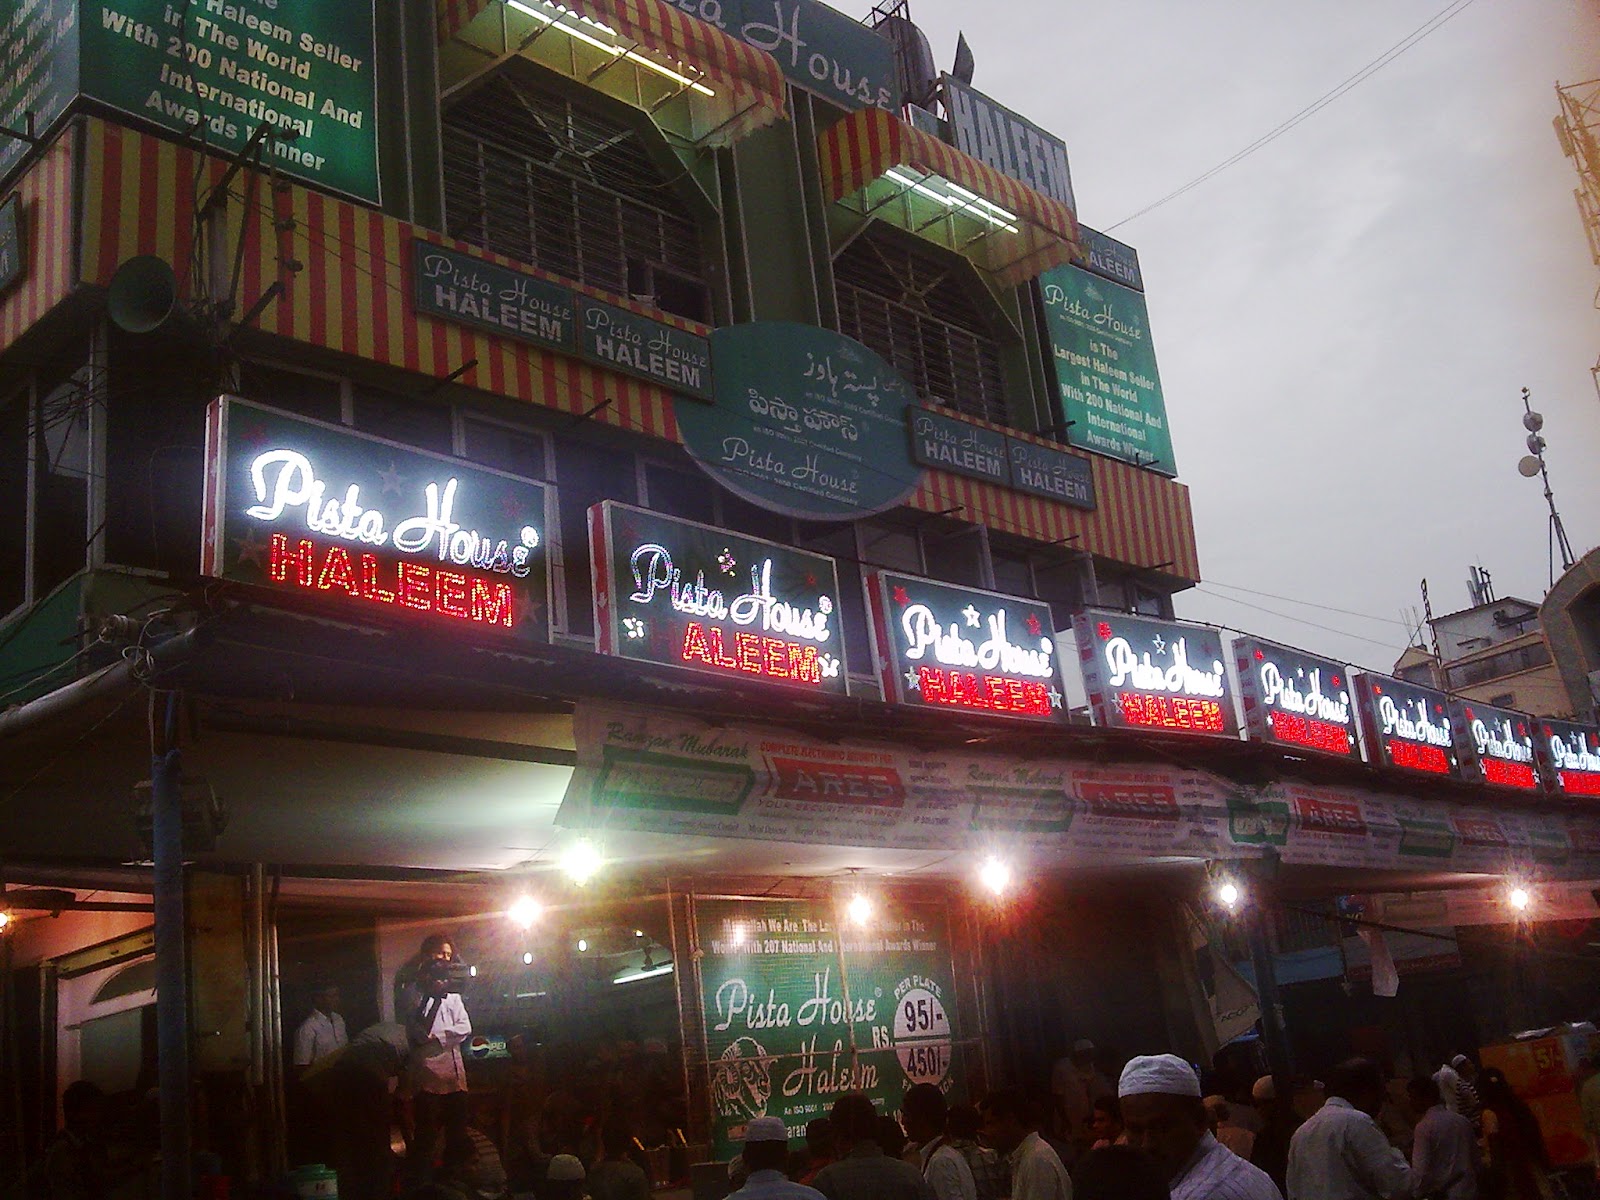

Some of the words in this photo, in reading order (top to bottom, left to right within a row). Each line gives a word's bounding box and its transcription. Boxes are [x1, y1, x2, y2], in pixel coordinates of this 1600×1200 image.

[196, 17, 239, 50] The
[247, 38, 311, 80] World
[206, 0, 292, 43] Haleem
[299, 33, 361, 72] Seller
[741, 1, 893, 112] House
[102, 7, 159, 48] With
[166, 36, 211, 69] 200
[219, 57, 314, 110] National
[321, 99, 362, 129] And
[160, 64, 313, 138] International
[424, 255, 492, 296] Pista
[500, 279, 571, 321] House
[1088, 251, 1135, 282] ALEEM
[435, 284, 561, 342] HALEEM
[586, 307, 642, 346] Pista
[648, 330, 707, 368] House
[1045, 284, 1090, 320] Pista
[1094, 304, 1141, 340] House
[596, 334, 700, 388] HALEEM
[1054, 344, 1091, 369] Largest
[1093, 353, 1127, 382] Haleem
[1129, 371, 1155, 391] Seller
[1100, 343, 1118, 361] The
[1061, 383, 1084, 403] With
[1086, 391, 1103, 409] 200
[1105, 397, 1143, 423] National
[1145, 410, 1162, 429] And
[1092, 375, 1110, 394] The
[1112, 381, 1137, 403] World
[917, 417, 958, 444] Pista
[1087, 411, 1146, 441] International
[1087, 430, 1121, 452] Awards
[722, 437, 786, 474] Pista
[791, 455, 858, 494] House
[925, 440, 1000, 477] HALEEM
[1020, 467, 1087, 501] HALEEM
[246, 449, 388, 546] Pista
[392, 477, 536, 578] House
[271, 533, 513, 628] HALEEM
[630, 543, 728, 620] Pista
[729, 558, 831, 643] House
[920, 665, 1051, 716] HALEEM
[793, 768, 894, 798] ARES
[764, 940, 779, 954] 207
[782, 940, 816, 954] National
[817, 940, 833, 953] And
[767, 919, 781, 933] We
[784, 919, 798, 932] Are
[714, 978, 792, 1031] Pista
[797, 964, 877, 1026] House
[893, 977, 912, 1000] PER
[913, 975, 942, 998] PLATE
[904, 1000, 943, 1033] 95/-
[782, 1032, 880, 1097] Haleem
[906, 1047, 948, 1078] 450/-
